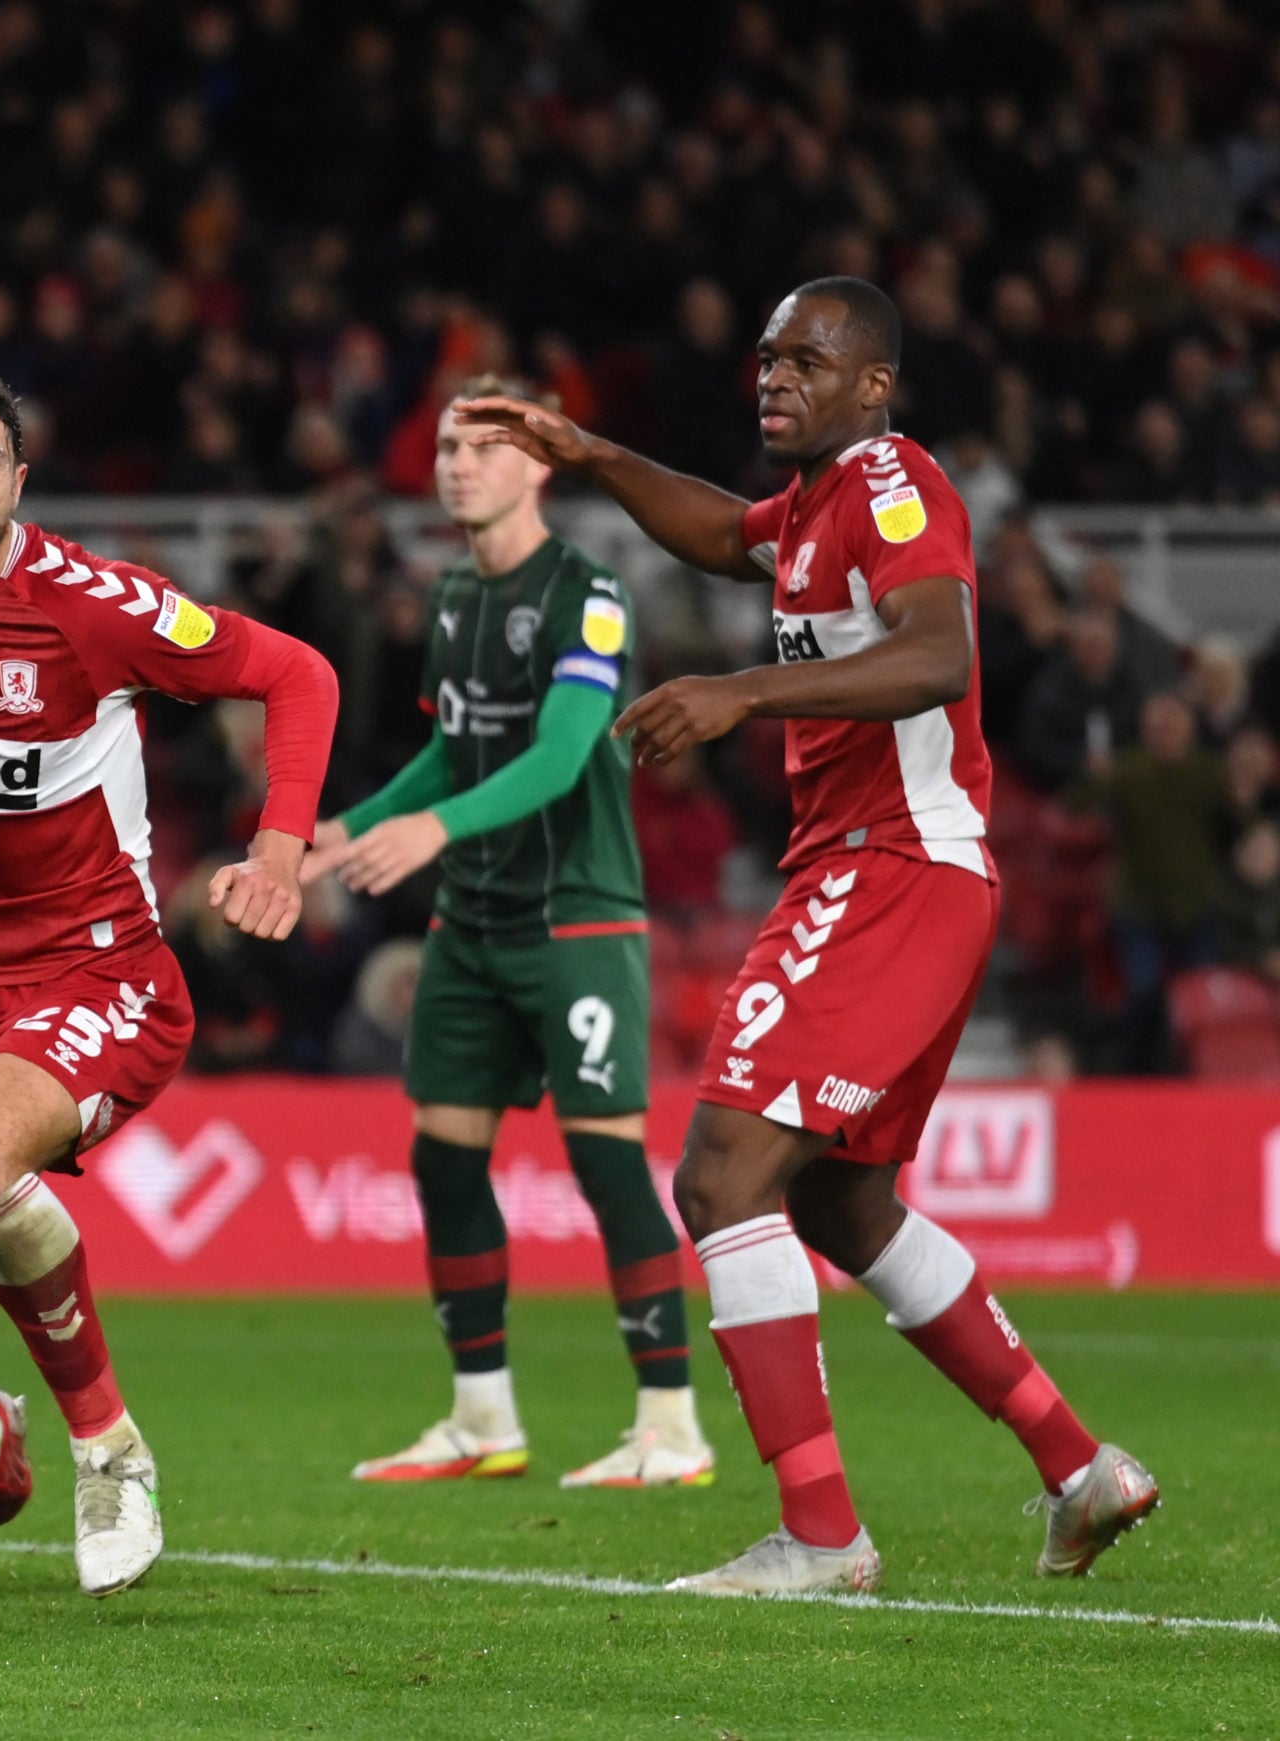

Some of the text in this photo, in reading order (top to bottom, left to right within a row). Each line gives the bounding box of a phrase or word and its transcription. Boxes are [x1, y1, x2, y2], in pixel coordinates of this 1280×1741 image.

[567, 995, 614, 1065] 9
[731, 981, 785, 1051] 9
[985, 1294, 1020, 1349] BORO
